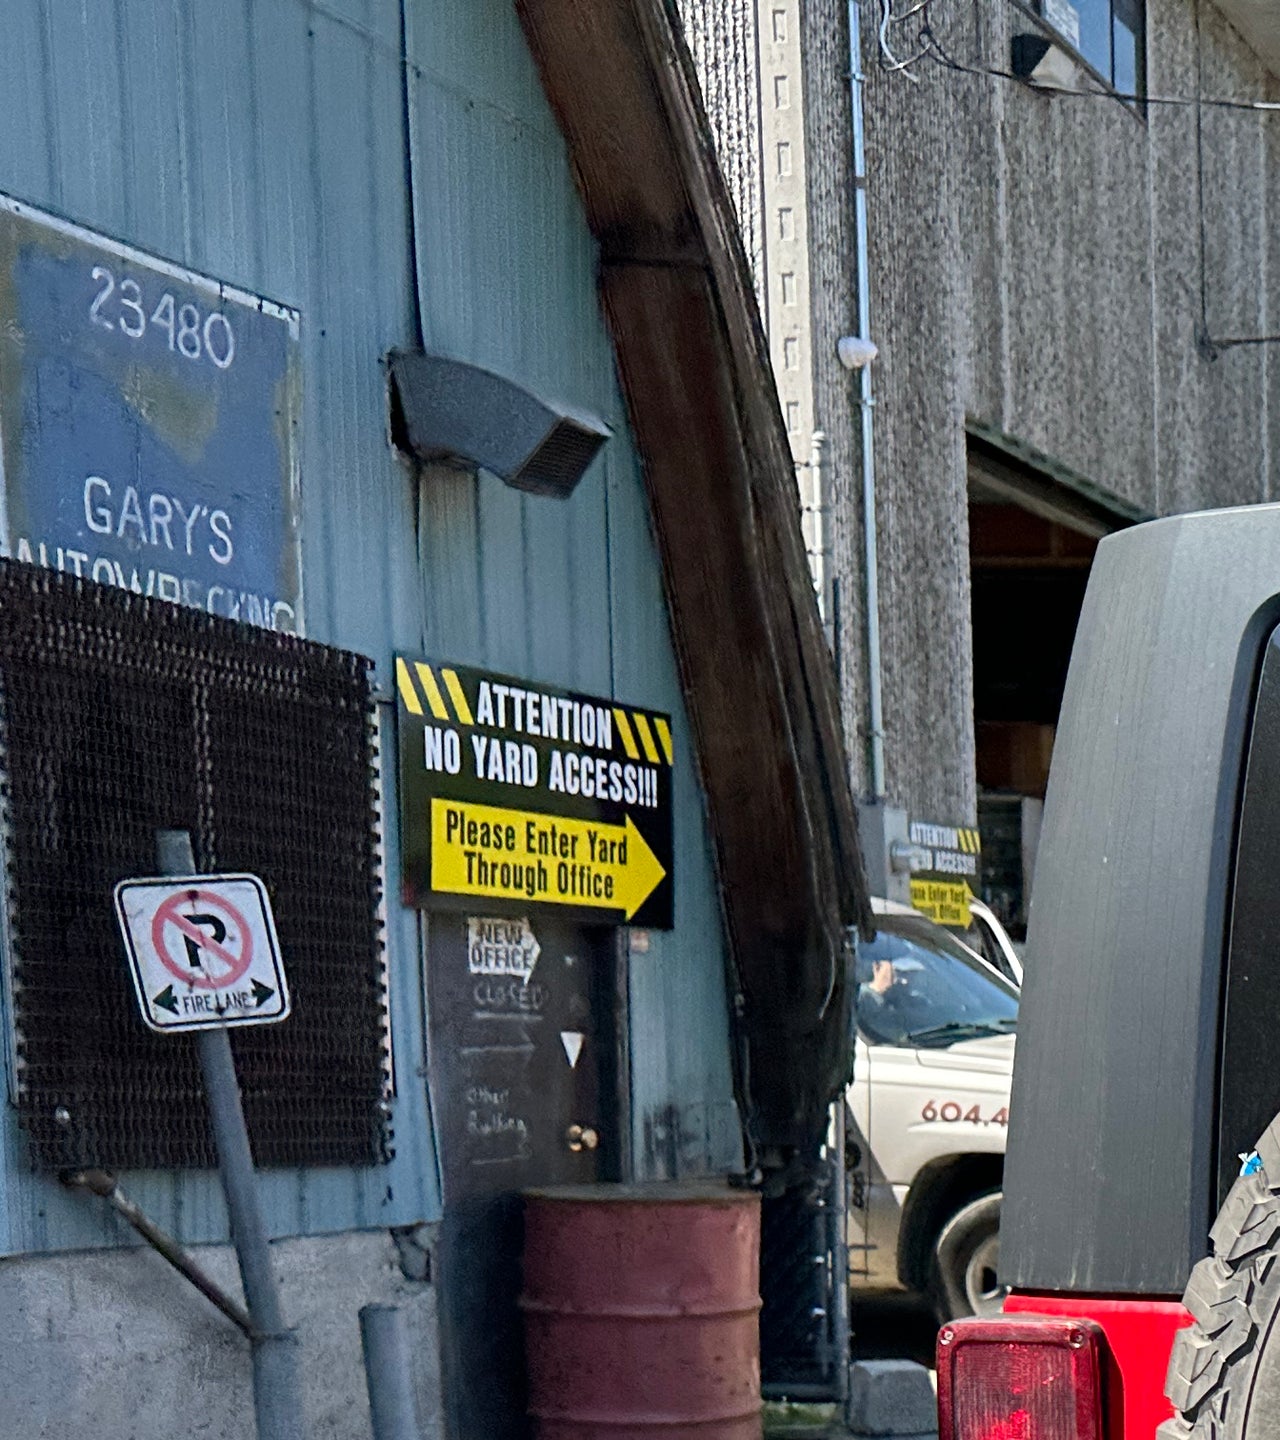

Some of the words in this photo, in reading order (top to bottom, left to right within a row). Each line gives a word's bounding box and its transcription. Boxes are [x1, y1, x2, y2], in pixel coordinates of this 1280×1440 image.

[90, 265, 236, 369] 23480
[83, 475, 233, 565] GARY'S
[477, 681, 613, 750] ATTENTION
[424, 725, 461, 774] NO
[471, 734, 538, 788] YARD
[549, 750, 658, 808] ACCESS!!!
[446, 809, 516, 850] Please
[526, 820, 578, 859] Enter
[586, 829, 628, 866] Yard
[464, 851, 548, 896] Through
[557, 861, 614, 899] Office
[471, 945, 531, 968] OFFICE
[183, 993, 211, 1013] FIRE
